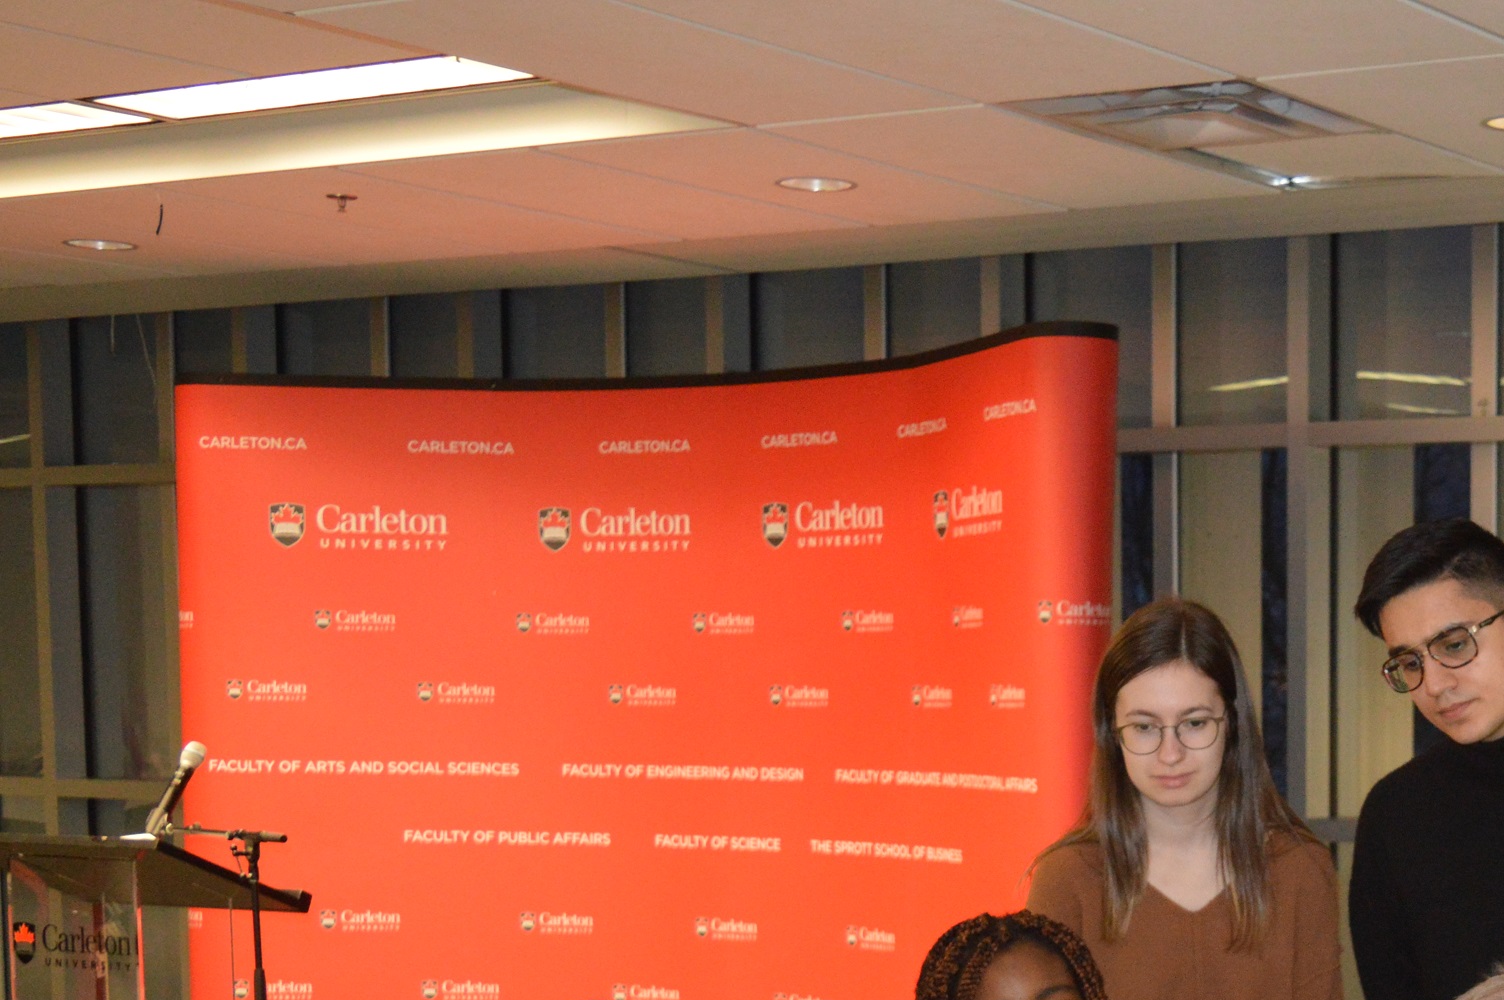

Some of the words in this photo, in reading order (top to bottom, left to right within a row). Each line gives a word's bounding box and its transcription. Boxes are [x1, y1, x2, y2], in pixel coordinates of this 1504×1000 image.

[198, 435, 307, 451] CARLETON.CA
[407, 439, 515, 455] CARLETON.CA
[598, 439, 691, 455] CARLETON.CA
[760, 431, 838, 449] CARLETON.CA
[951, 486, 1003, 520] Carleton
[315, 504, 448, 535] Carleton
[580, 507, 691, 537] Carleton
[795, 500, 884, 532] Carleton
[953, 520, 1002, 538] UNIVERSITY
[319, 537, 447, 551] UNIVERSITY
[582, 540, 690, 553] UNIVERSITY
[797, 533, 883, 548] UNIVERSITY
[335, 609, 396, 625] Carleton
[536, 612, 590, 627] Carleton
[708, 612, 755, 627] Carleton
[855, 611, 894, 624] Carleton
[247, 679, 307, 695] Carleton
[438, 681, 495, 697] Carleton
[626, 684, 677, 699] Carleton
[784, 684, 829, 699] Carleton
[208, 759, 275, 774] FACULTY
[279, 760, 300, 774] OF
[305, 760, 345, 775] ARTS
[350, 760, 384, 775] AND
[386, 761, 444, 776] SOCIAL
[448, 762, 519, 776] SCIENCES
[561, 762, 622, 777] FACULTY
[625, 764, 644, 778] OF
[646, 765, 729, 780] ENGINEERING
[732, 766, 758, 781] AND
[760, 766, 804, 782] DESIGN
[834, 768, 878, 784] FACULTY
[881, 770, 894, 784] OF
[896, 771, 941, 787] GRADUATE
[942, 773, 959, 788] AND
[403, 829, 469, 844] FACULTY
[473, 830, 496, 844] OF
[499, 830, 550, 845] PUBLIC
[553, 831, 611, 846] AFFAIRS
[654, 834, 710, 849] FACULTY
[711, 835, 730, 850] OF
[731, 837, 782, 852] SCIENCE
[809, 838, 832, 854] THE
[834, 840, 873, 856] SPROTT
[874, 843, 911, 859] SCHOOL
[914, 845, 926, 859] OF
[340, 909, 401, 924] Carleton
[539, 911, 593, 926] Carleton
[711, 917, 758, 933] Carleton
[42, 924, 130, 956] Carleton
[859, 927, 896, 944] Carleton
[45, 958, 130, 972] UNIVERSITY
[267, 979, 313, 994] arleton
[442, 979, 500, 995] Carleton
[630, 984, 680, 1000] Carleton
